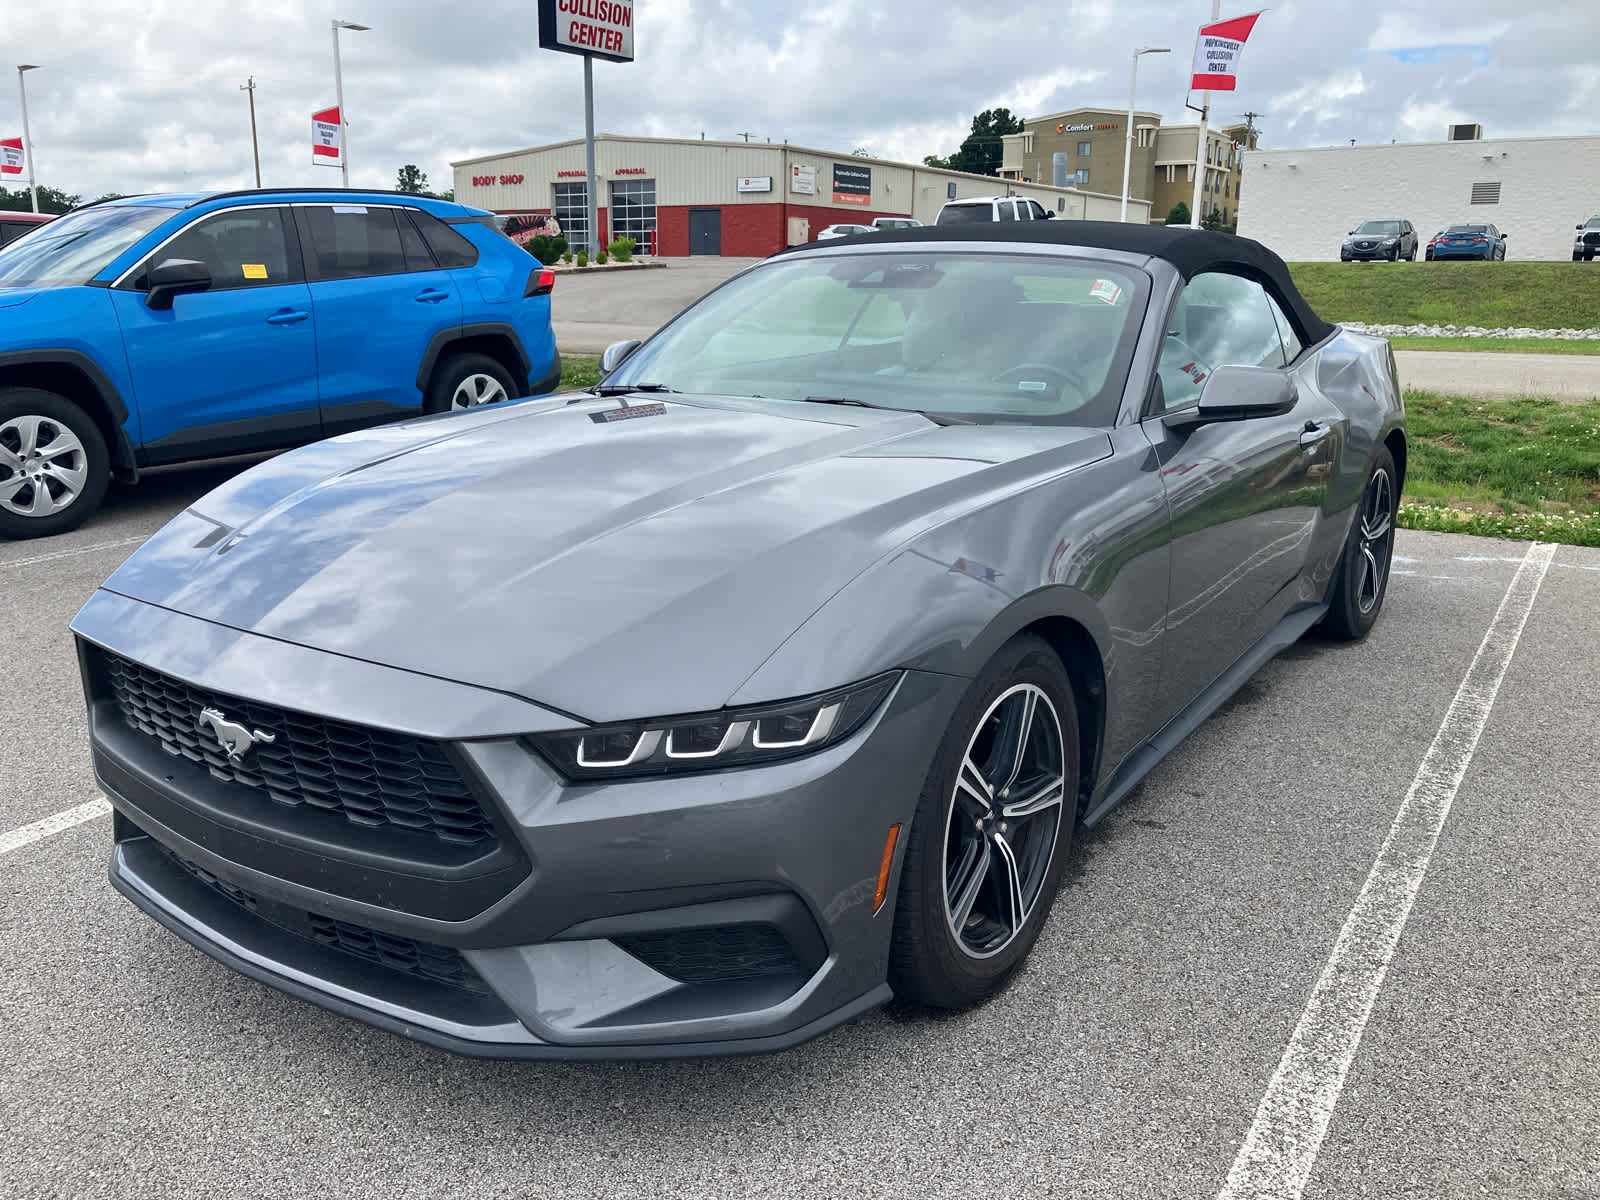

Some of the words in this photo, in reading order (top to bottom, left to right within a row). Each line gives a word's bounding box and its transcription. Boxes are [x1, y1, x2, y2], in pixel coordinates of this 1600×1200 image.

[559, 0, 631, 27] COLLISION
[569, 20, 623, 52] CENTER
[1204, 38, 1240, 50] HOPKINSVILLE
[1206, 51, 1233, 60] COLLISION
[1208, 63, 1227, 72] CENTER
[1066, 123, 1094, 132] Comfort
[472, 176, 496, 186] BODY
[499, 174, 524, 185] SHOP
